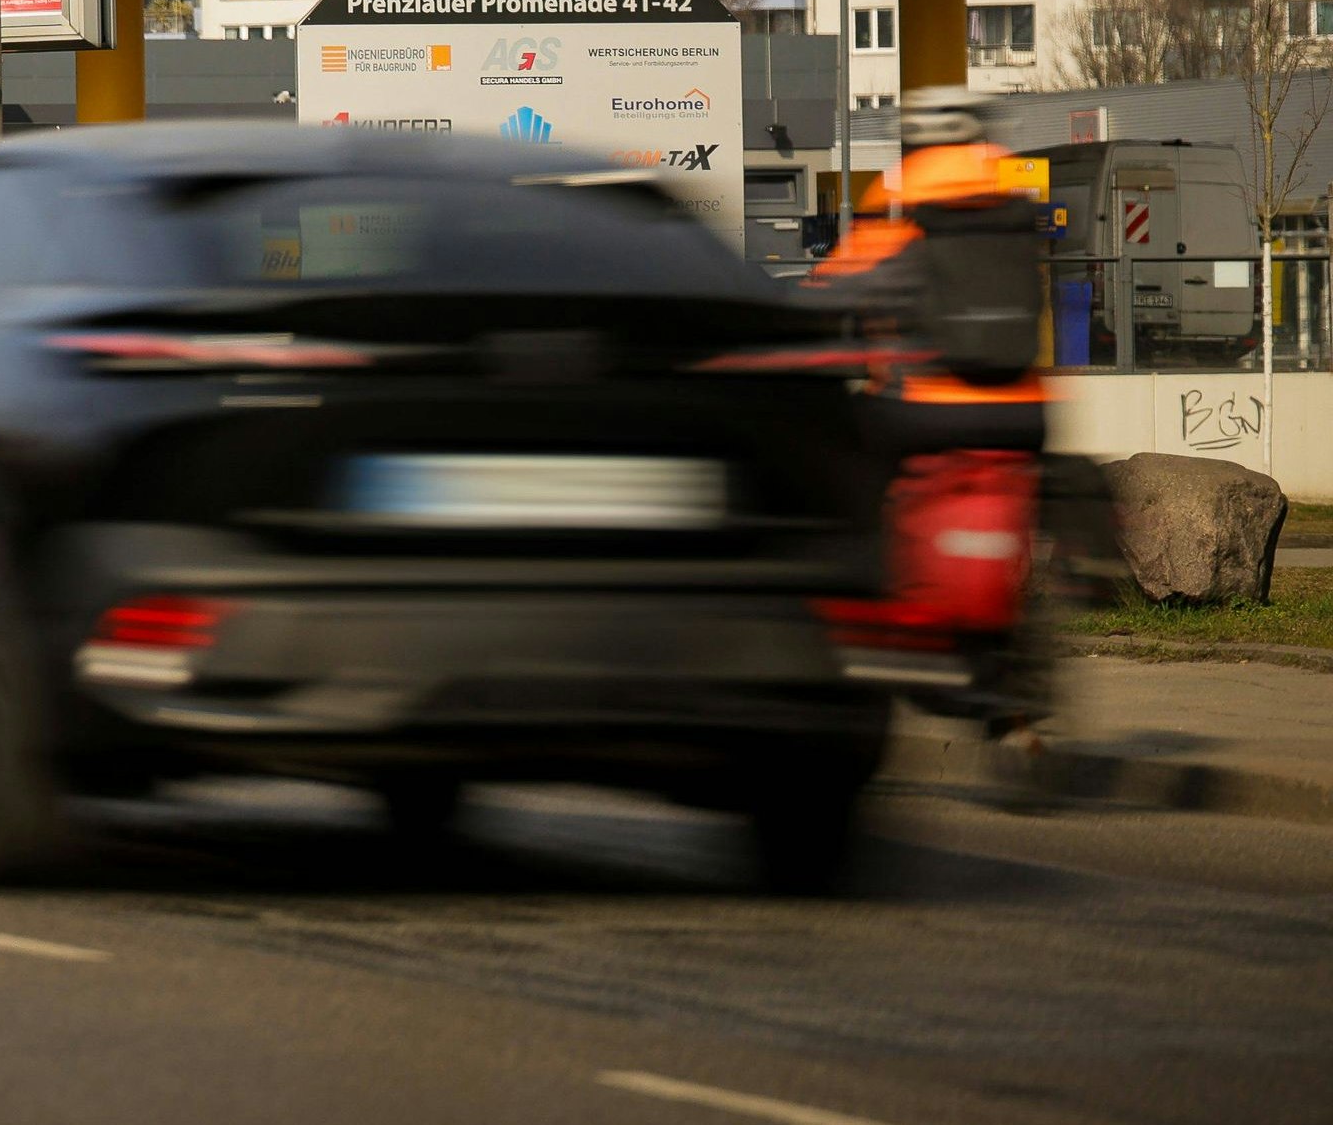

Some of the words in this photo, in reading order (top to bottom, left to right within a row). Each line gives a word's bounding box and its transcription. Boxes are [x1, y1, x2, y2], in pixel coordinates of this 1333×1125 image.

[347, 47, 425, 60] INGENIEURBÜRO
[480, 37, 562, 71] AGS
[588, 48, 679, 57] WERTSICHERUNG
[681, 48, 719, 56] BERLIN
[355, 62, 371, 72] FÜR
[373, 63, 417, 72] BAUGRUND
[612, 98, 704, 111] Eurohome
